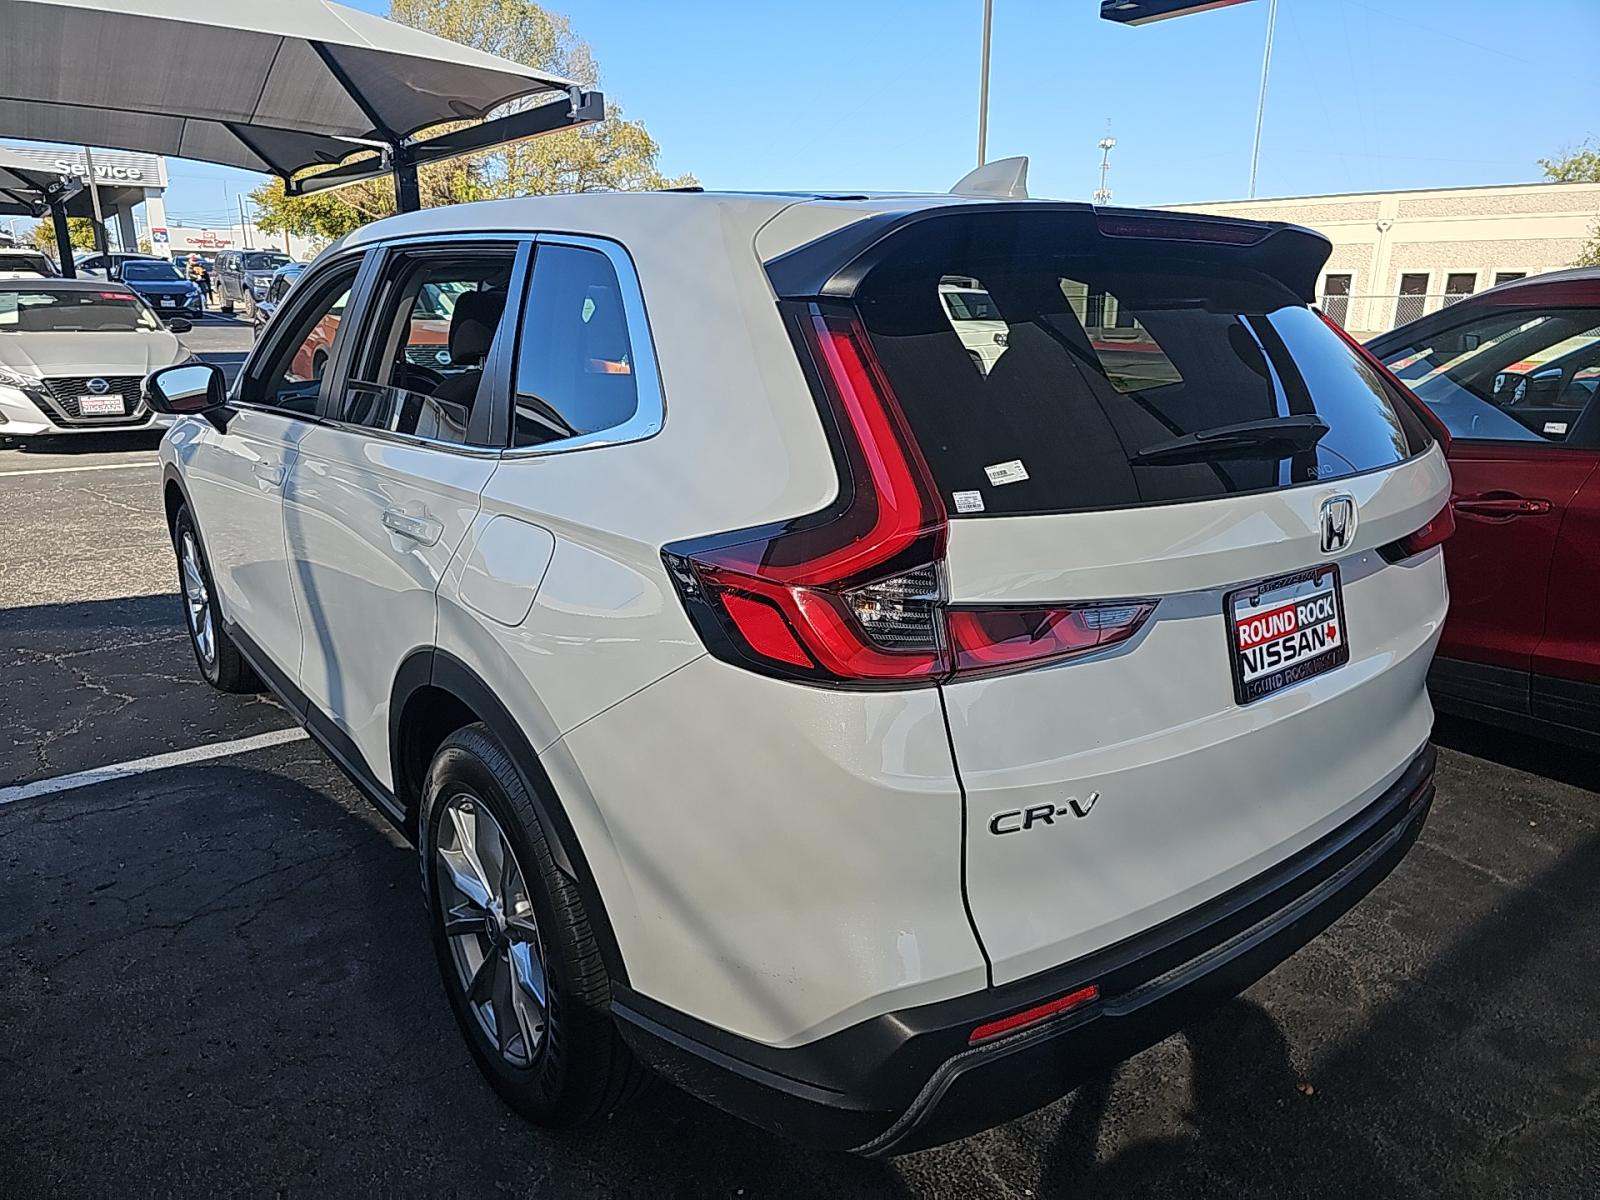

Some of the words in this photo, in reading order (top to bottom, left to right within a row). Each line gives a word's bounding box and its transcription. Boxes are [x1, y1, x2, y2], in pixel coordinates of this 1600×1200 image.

[1238, 610, 1296, 647] ROUND
[1297, 595, 1334, 627] ROCK
[1239, 624, 1326, 675] NISSAN
[989, 791, 1100, 836] CR-V
